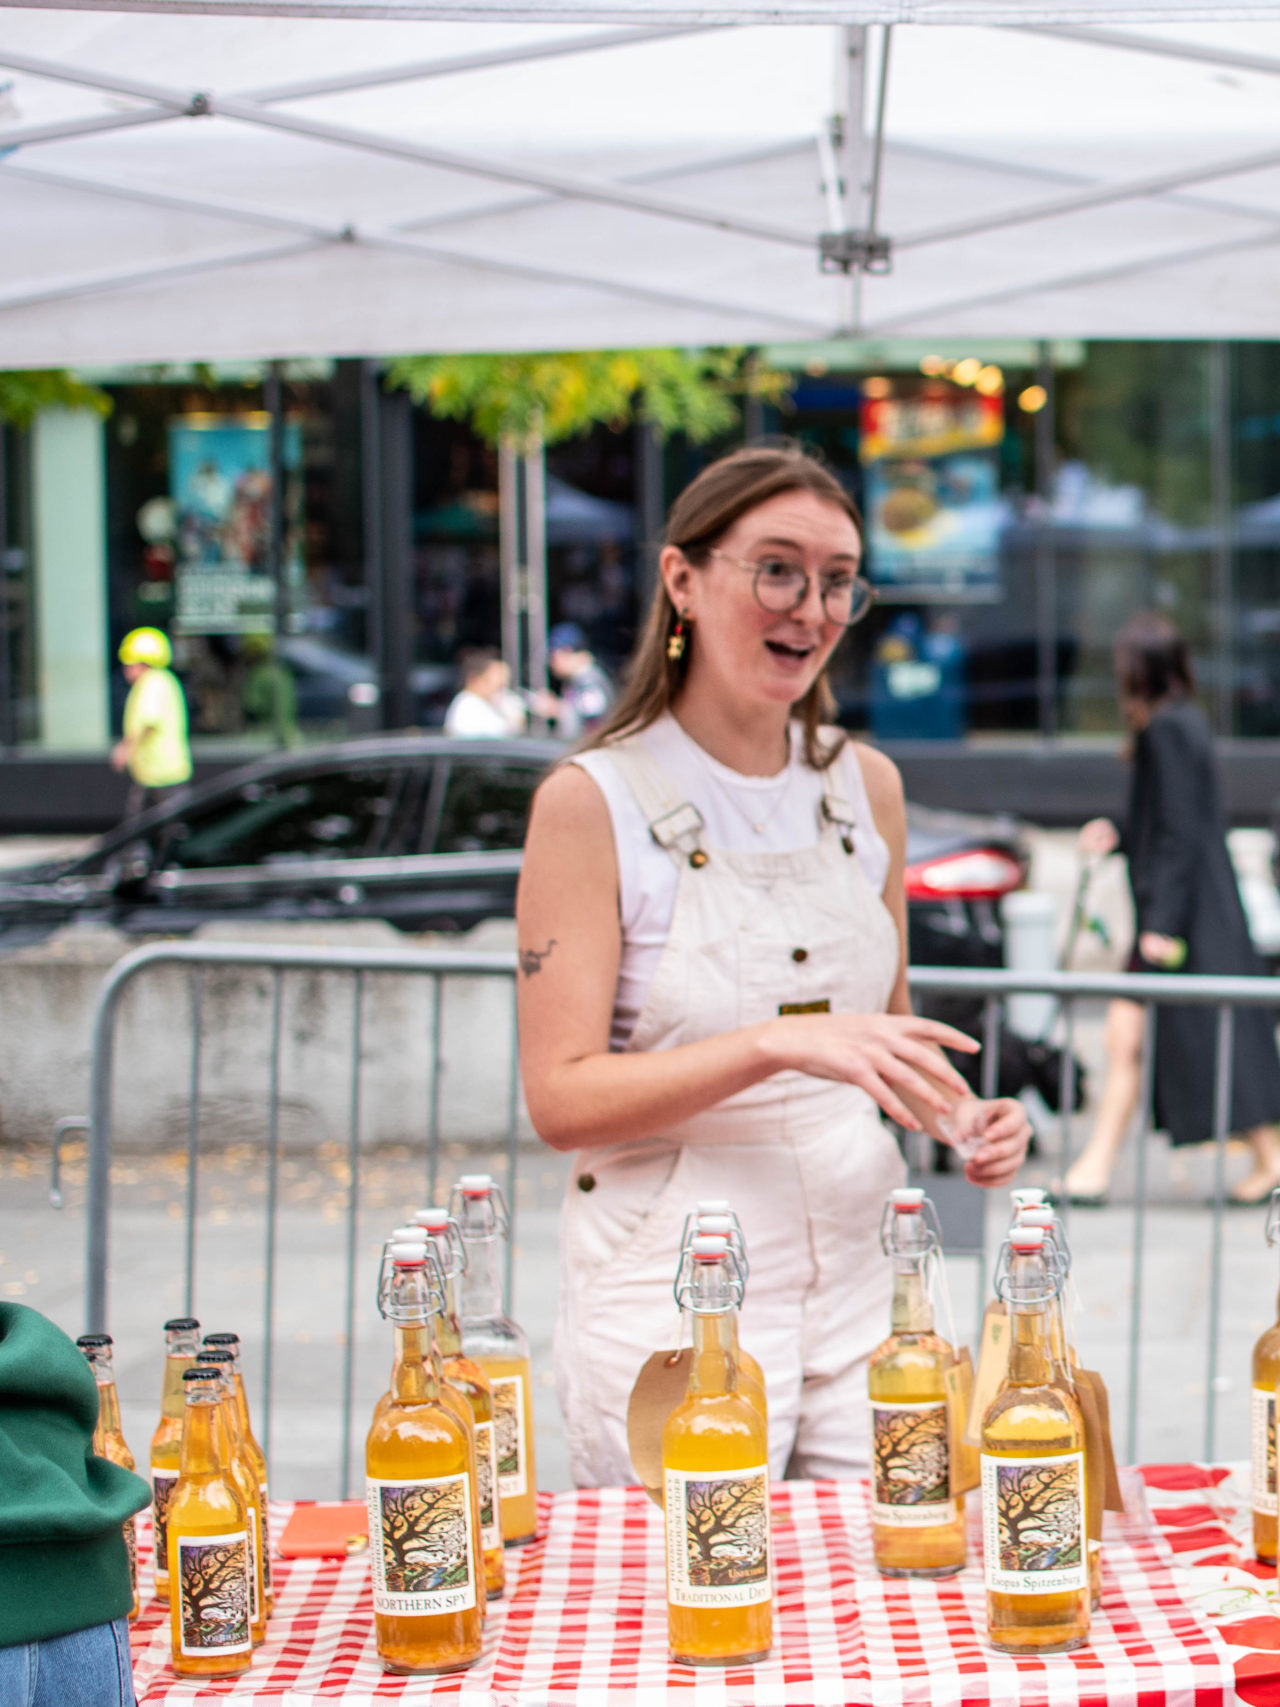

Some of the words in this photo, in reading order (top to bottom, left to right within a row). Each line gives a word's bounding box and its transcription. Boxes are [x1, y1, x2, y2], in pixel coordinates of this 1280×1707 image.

[1023, 1574, 1081, 1591] Spitzenburg
[375, 1597, 442, 1611] NORTHERN
[446, 1593, 467, 1605] SPY
